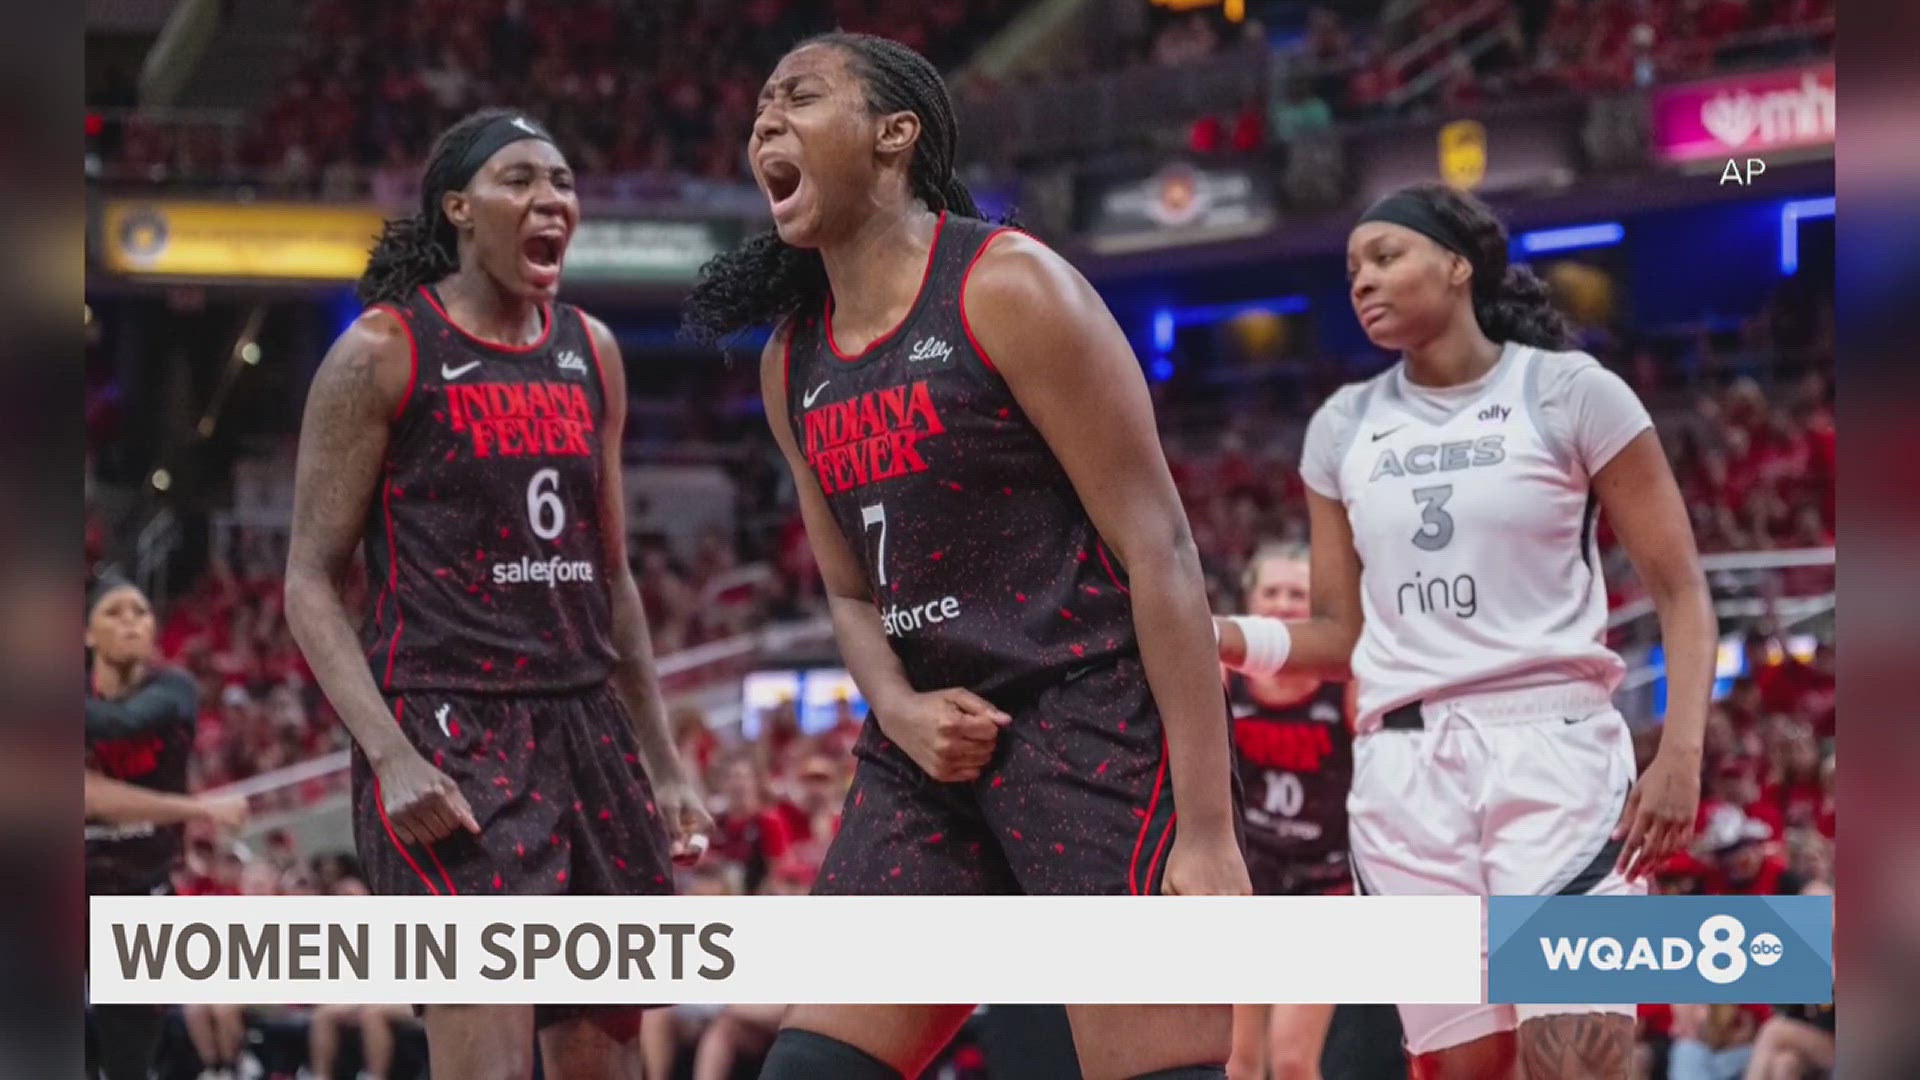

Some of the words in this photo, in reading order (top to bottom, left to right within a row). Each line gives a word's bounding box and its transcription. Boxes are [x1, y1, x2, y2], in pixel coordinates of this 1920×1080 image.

[909, 336, 952, 362] Lilly
[445, 381, 594, 432] INDIANA
[803, 380, 945, 467] INDIANA
[1478, 404, 1512, 423] ally
[471, 418, 591, 459] FEVER
[814, 427, 929, 496] FEVER
[1369, 436, 1506, 482] ACES
[526, 468, 566, 540] 6
[1411, 483, 1455, 551] 3
[861, 501, 887, 586] 7
[882, 595, 960, 638] sforce
[1397, 570, 1478, 618] ring
[1264, 770, 1304, 818] 10
